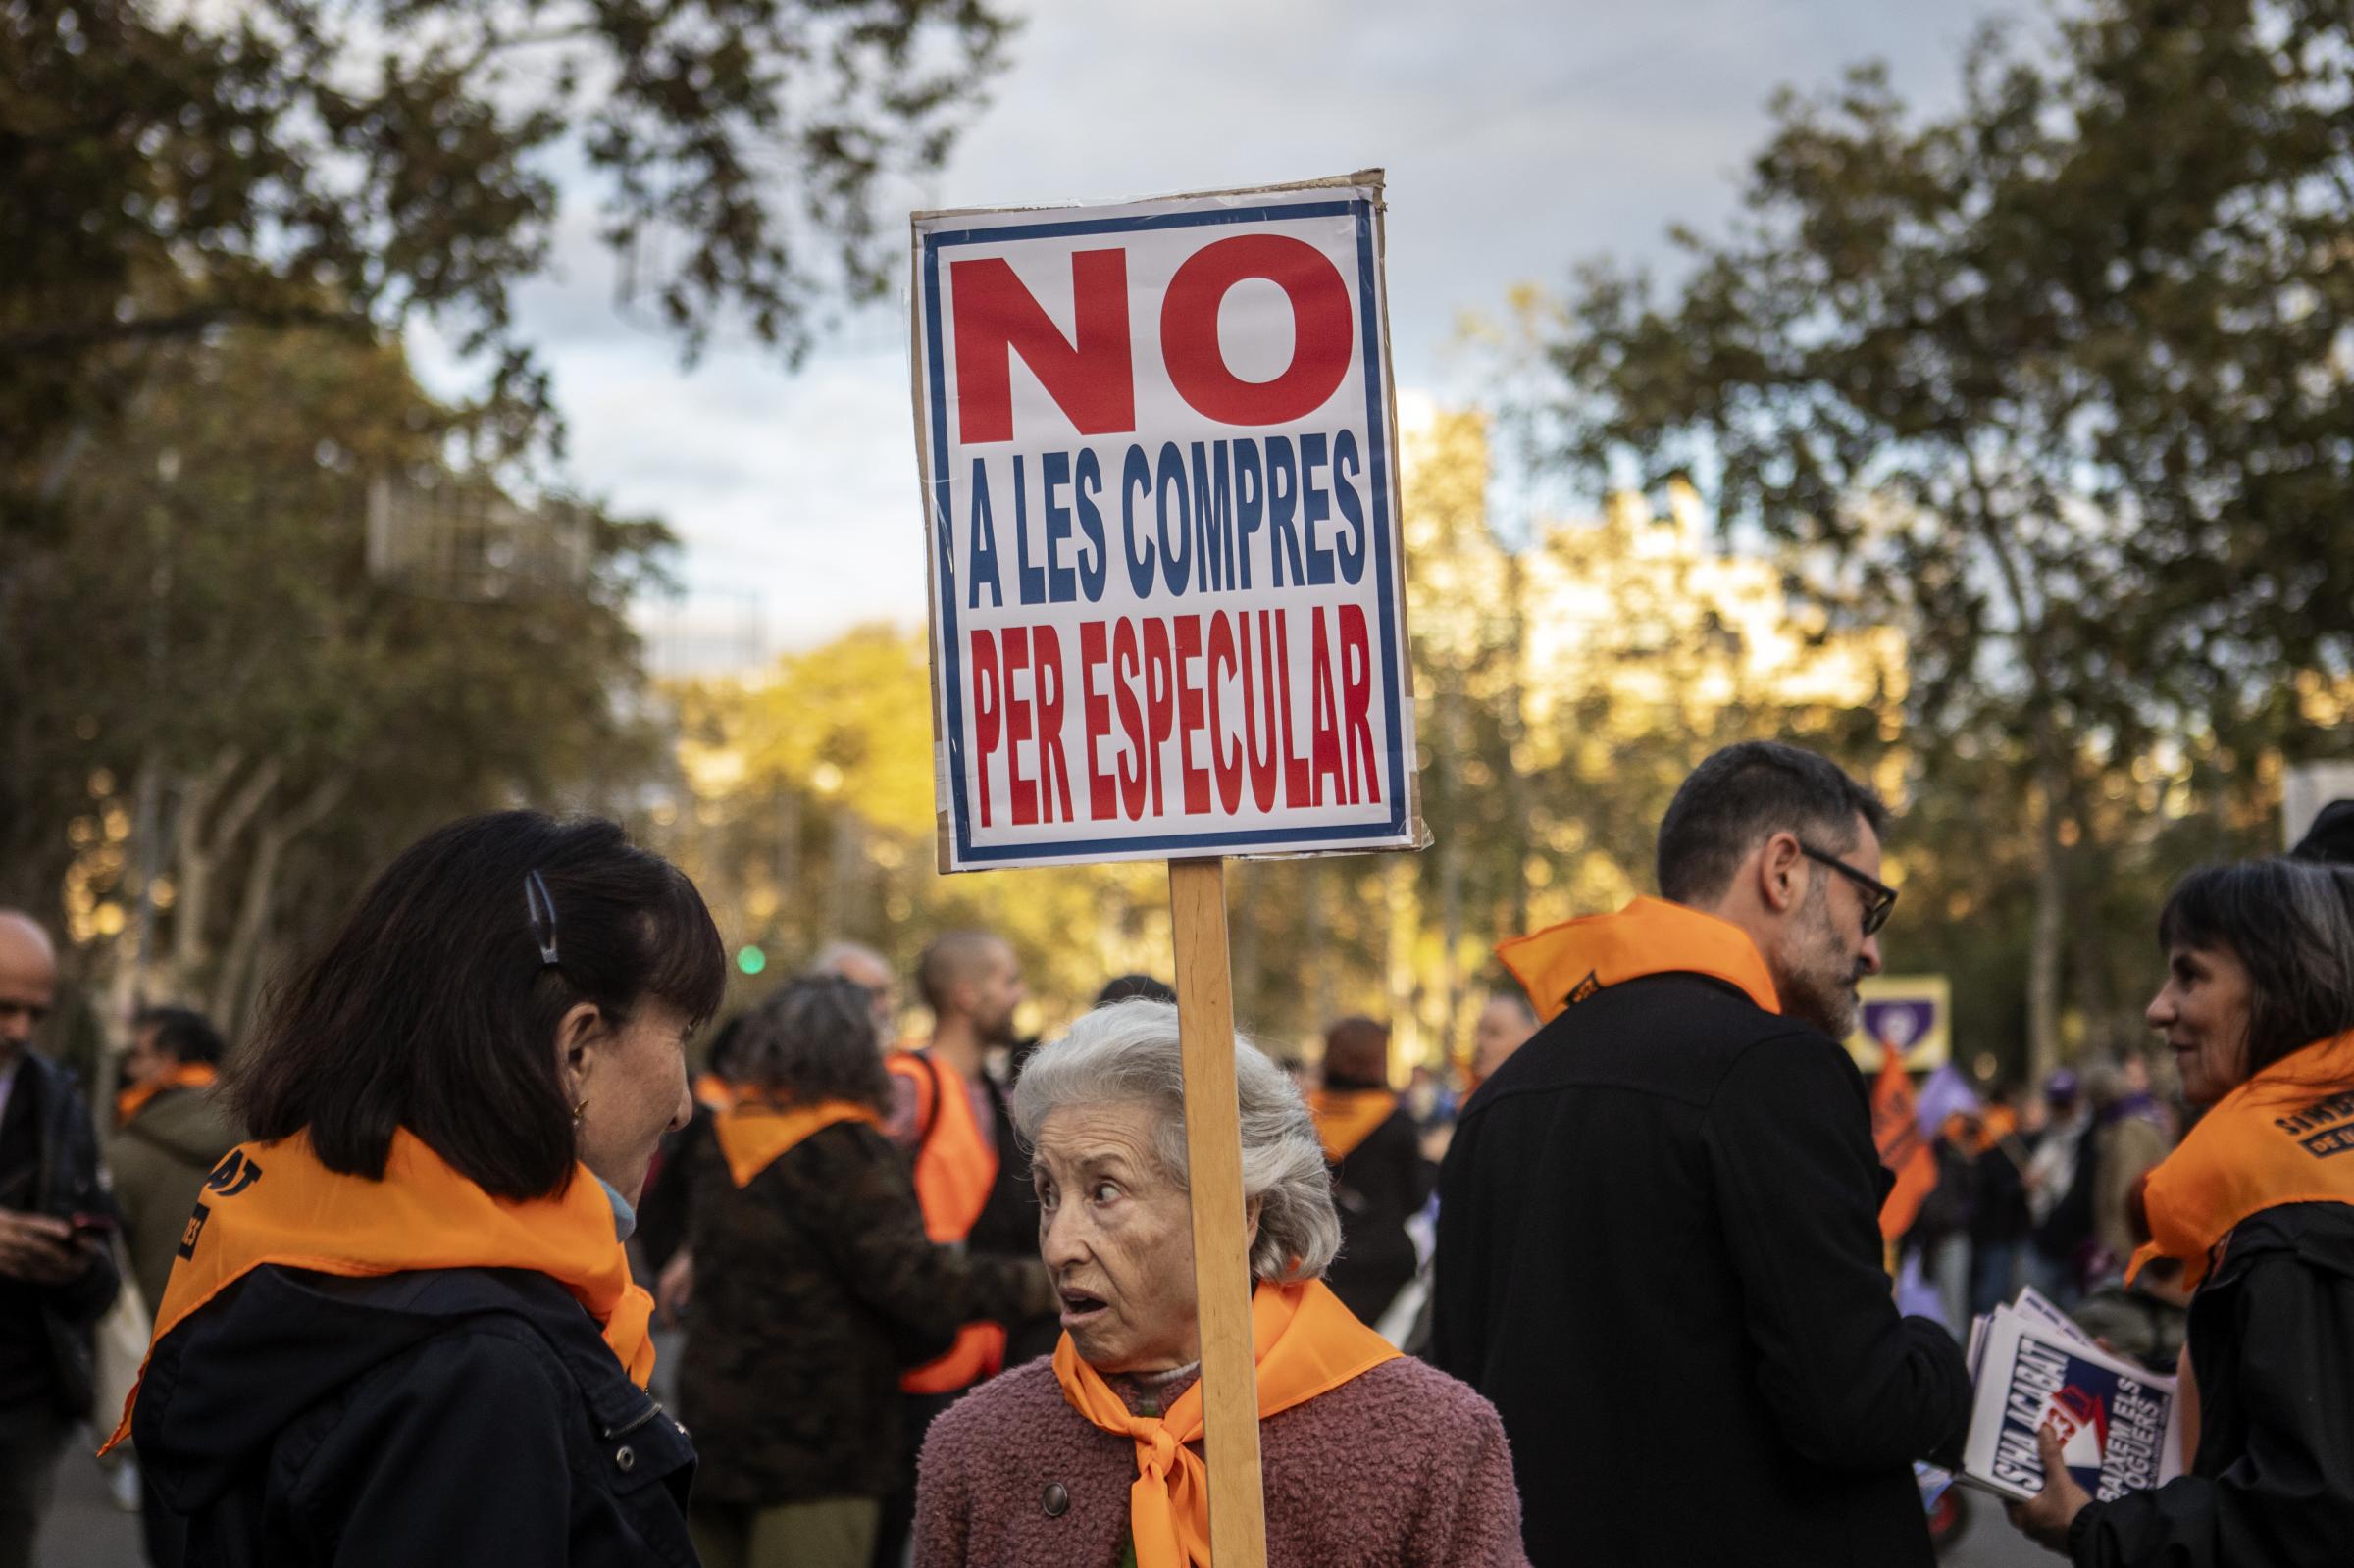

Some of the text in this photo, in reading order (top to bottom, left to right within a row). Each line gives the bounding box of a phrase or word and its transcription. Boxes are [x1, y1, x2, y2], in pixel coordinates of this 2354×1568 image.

[950, 233, 1354, 444] NO
[968, 429, 1366, 609] A LES COMPRES
[970, 604, 1381, 829] PER ESPECULAR
[2007, 1338, 2070, 1434] ACABAT
[2112, 1378, 2141, 1420] ELS
[2121, 1399, 2159, 1497] OGUERS
